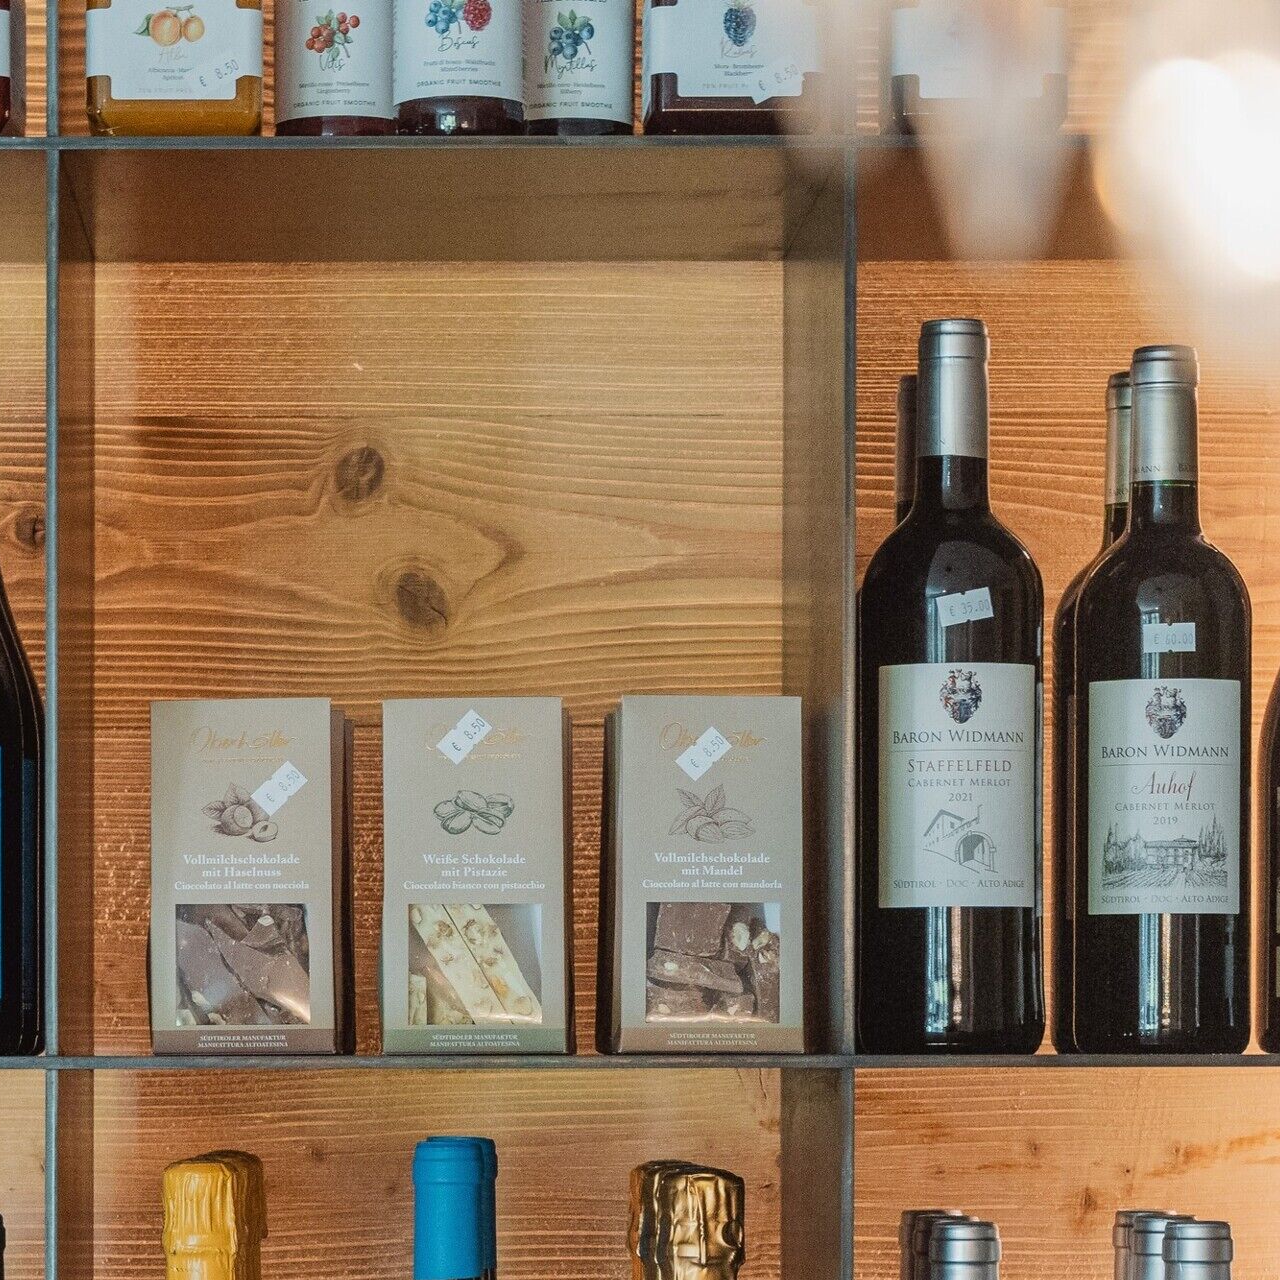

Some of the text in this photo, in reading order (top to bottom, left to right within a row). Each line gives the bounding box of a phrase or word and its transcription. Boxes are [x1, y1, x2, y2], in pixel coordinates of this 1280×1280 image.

[961, 599, 991, 616] 35.00
[463, 718, 485, 740] 8.50
[893, 729, 1024, 744] BARON WIDMANN
[704, 735, 724, 757] 8.50
[1102, 745, 1229, 759] BARON WIDMANN
[908, 759, 1012, 773] STAFFELFELD
[908, 779, 1011, 787] CABERNET MERLOT
[1131, 771, 1197, 801] Auhof
[948, 793, 973, 802] 2021
[1115, 802, 1215, 811] CABERNET MERLOT
[1153, 816, 1178, 825] 2019
[183, 853, 300, 865] Vollmilchschokolade
[461, 854, 526, 865] Schokolade
[654, 852, 770, 864] Vollmilchschokolade
[202, 867, 282, 877] mit Haselnuss
[441, 867, 508, 877] mit Pistazie
[681, 866, 743, 876] mit Mandel
[175, 881, 221, 890] Cioccolato
[403, 881, 450, 890] Cioccolato
[642, 879, 690, 888] Cioccolato
[977, 879, 1000, 888] ALTO
[1181, 895, 1205, 903] ALTO
